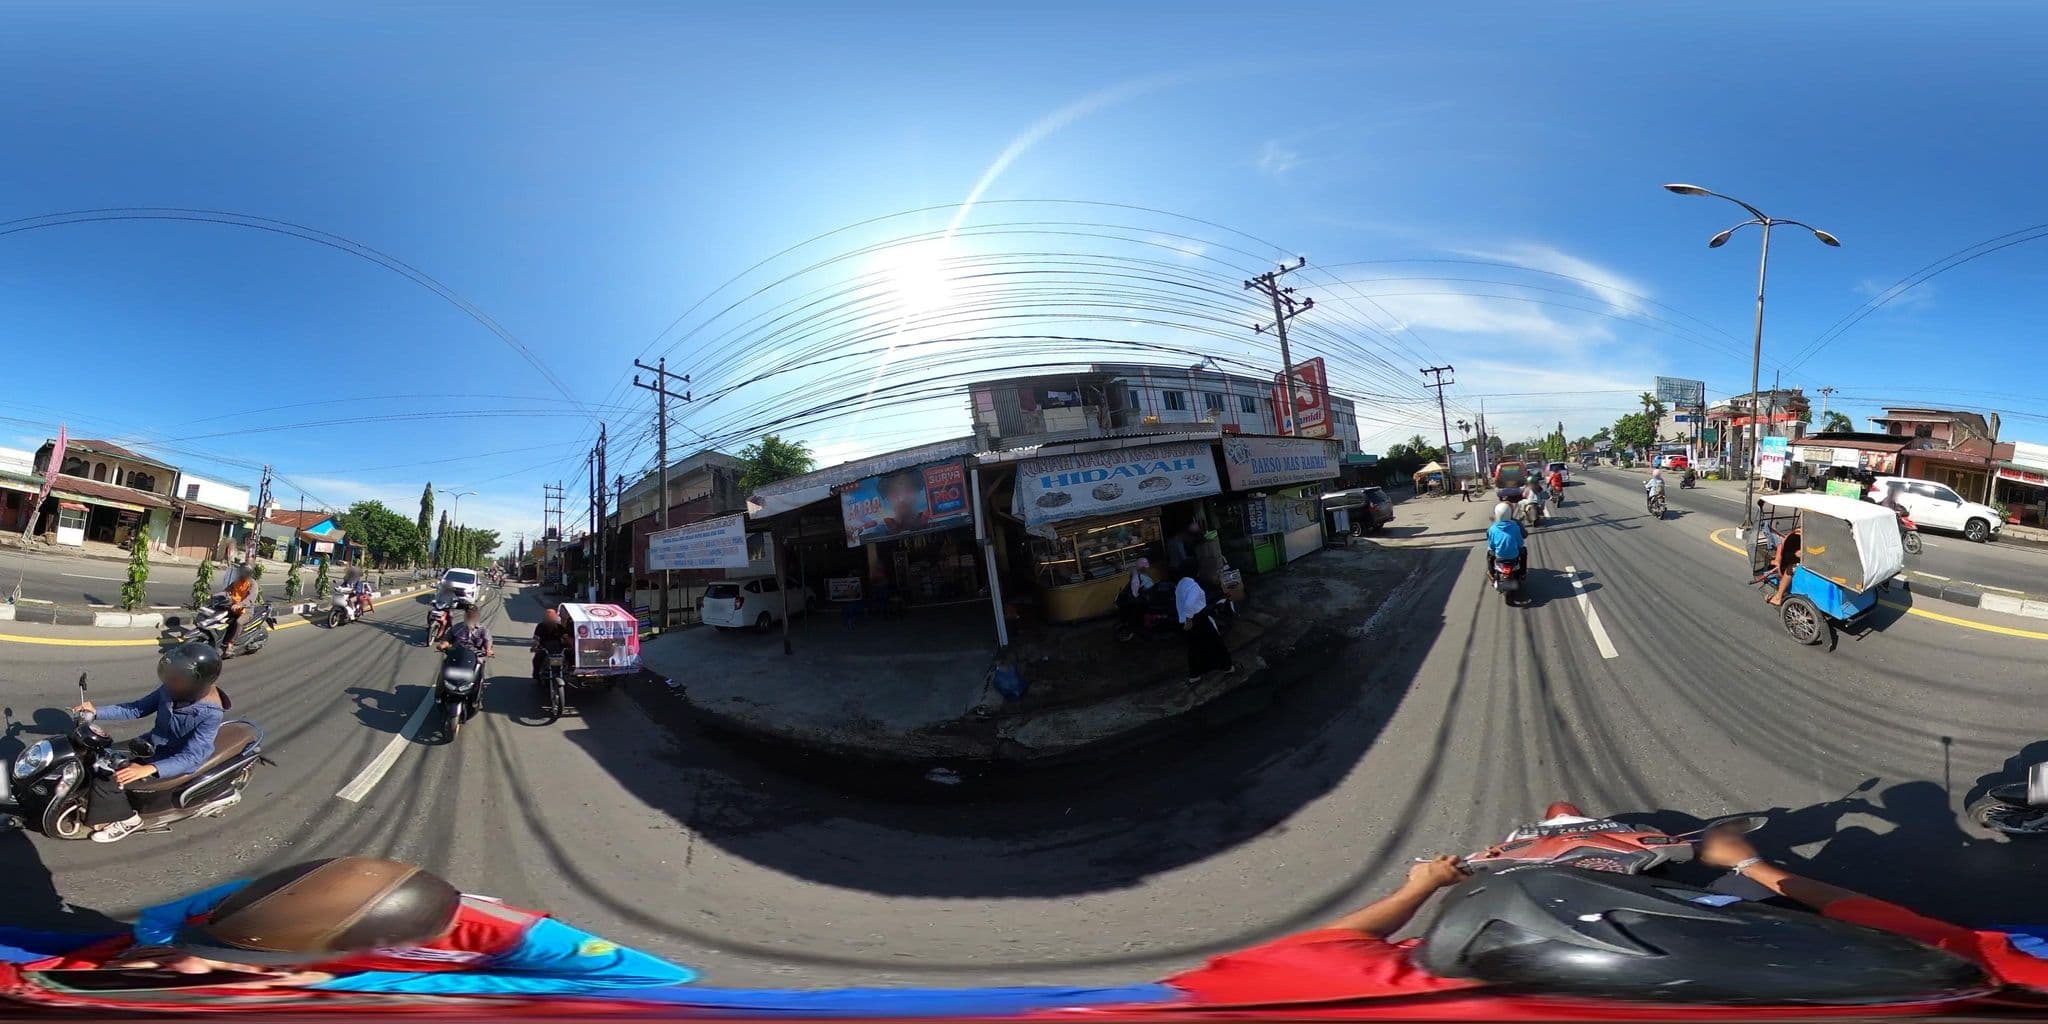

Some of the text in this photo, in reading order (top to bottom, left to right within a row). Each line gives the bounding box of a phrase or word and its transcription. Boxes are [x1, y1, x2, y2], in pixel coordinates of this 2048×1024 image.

[1022, 455, 1073, 476] RUMAH
[1077, 449, 1128, 469] MAKAN
[1129, 446, 1156, 462] NASI
[1252, 455, 1328, 474] BAKSO MAS RAHMAT
[928, 471, 961, 484] SURYA
[1040, 458, 1195, 488] HIDAYAH
[934, 488, 959, 502] PRO
[1248, 503, 1257, 528] OPEN
